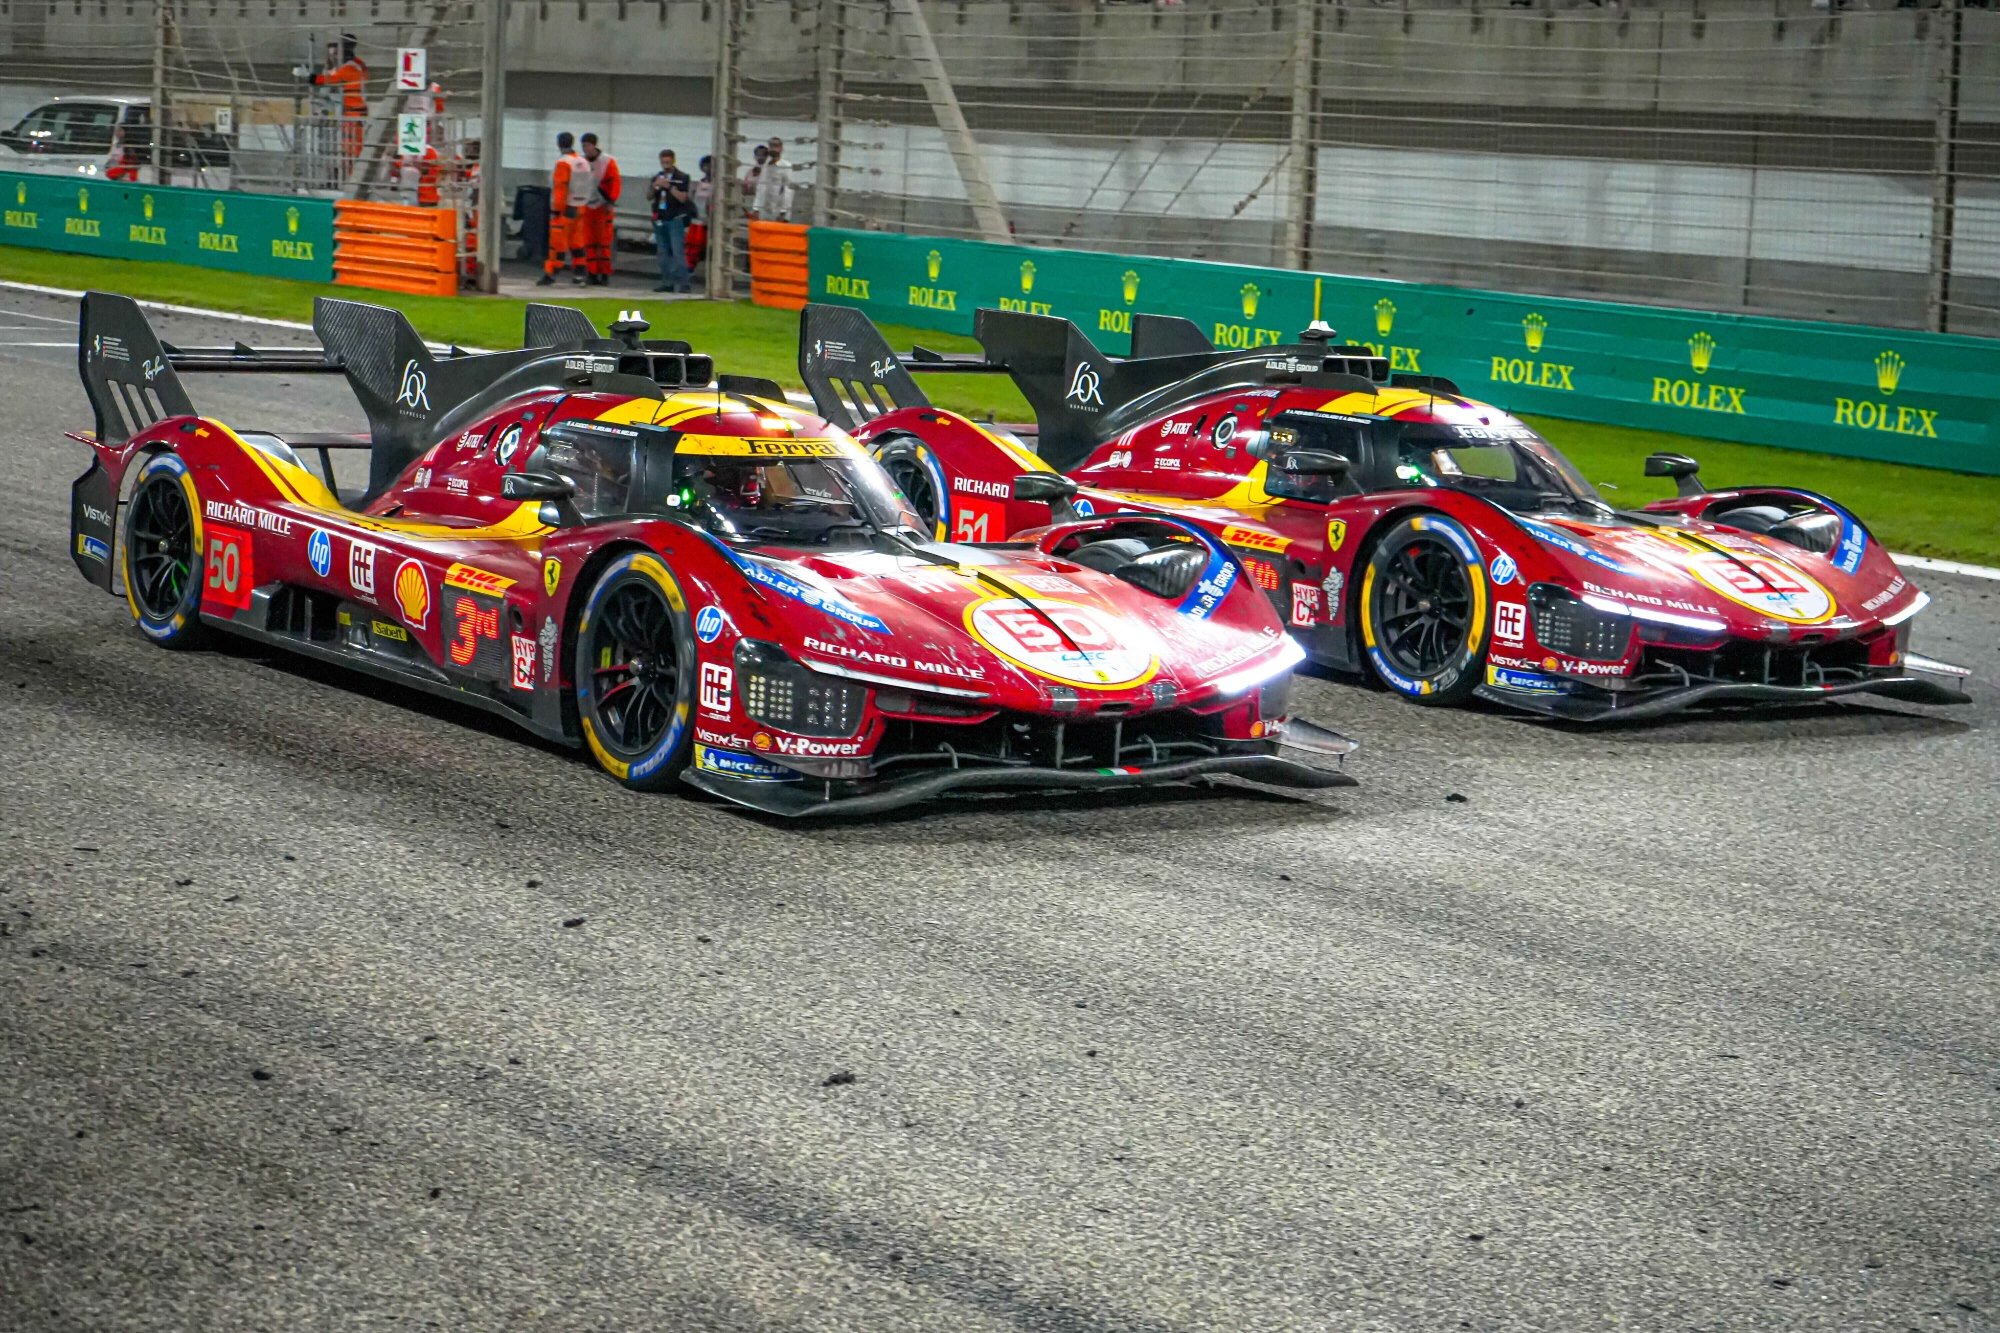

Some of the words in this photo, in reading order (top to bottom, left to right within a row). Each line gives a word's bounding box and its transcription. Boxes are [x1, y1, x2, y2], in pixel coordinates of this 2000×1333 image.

[4, 210, 38, 229] ROLEX
[65, 218, 100, 238] ROLEX
[130, 225, 166, 245] ROLEX
[198, 232, 239, 253] ROLEX
[271, 240, 314, 261] ROLEX
[826, 275, 870, 300] ROLEX
[908, 286, 957, 311] ROLEX
[1099, 309, 1131, 334] ROL
[1214, 323, 1281, 350] ROLEX
[565, 360, 585, 370] ADLER
[593, 363, 614, 374] GROUP
[1266, 361, 1287, 371] ADLER
[1296, 365, 1318, 373] GROUP
[1490, 356, 1575, 390] ROLEX
[1651, 377, 1745, 415] ROLEX
[1170, 423, 1192, 435] AT&T
[1833, 397, 1938, 439] ROLEX
[954, 477, 1009, 499] RICHARD
[206, 500, 255, 526] RICHARD
[257, 512, 291, 535] MILLE
[958, 509, 988, 543] 51
[1231, 530, 1279, 547] DHL
[1526, 527, 1569, 549] ADLER
[310, 530, 331, 576] hp
[209, 539, 240, 593] 50
[453, 567, 501, 590] DHL
[1491, 555, 1516, 584] hp
[1708, 562, 1801, 590] 51
[743, 567, 799, 598] ADLER
[822, 601, 880, 629] GROUP
[1583, 581, 1663, 606] RICHARD
[1666, 599, 1720, 615] MILLE
[375, 623, 404, 640] Sabelt
[697, 607, 723, 643] hp
[1000, 611, 1110, 653] 50
[803, 637, 908, 667] RICHARD
[914, 660, 985, 680] MILLE
[1562, 660, 1626, 675] V-Power
[776, 737, 861, 756] V-Power
